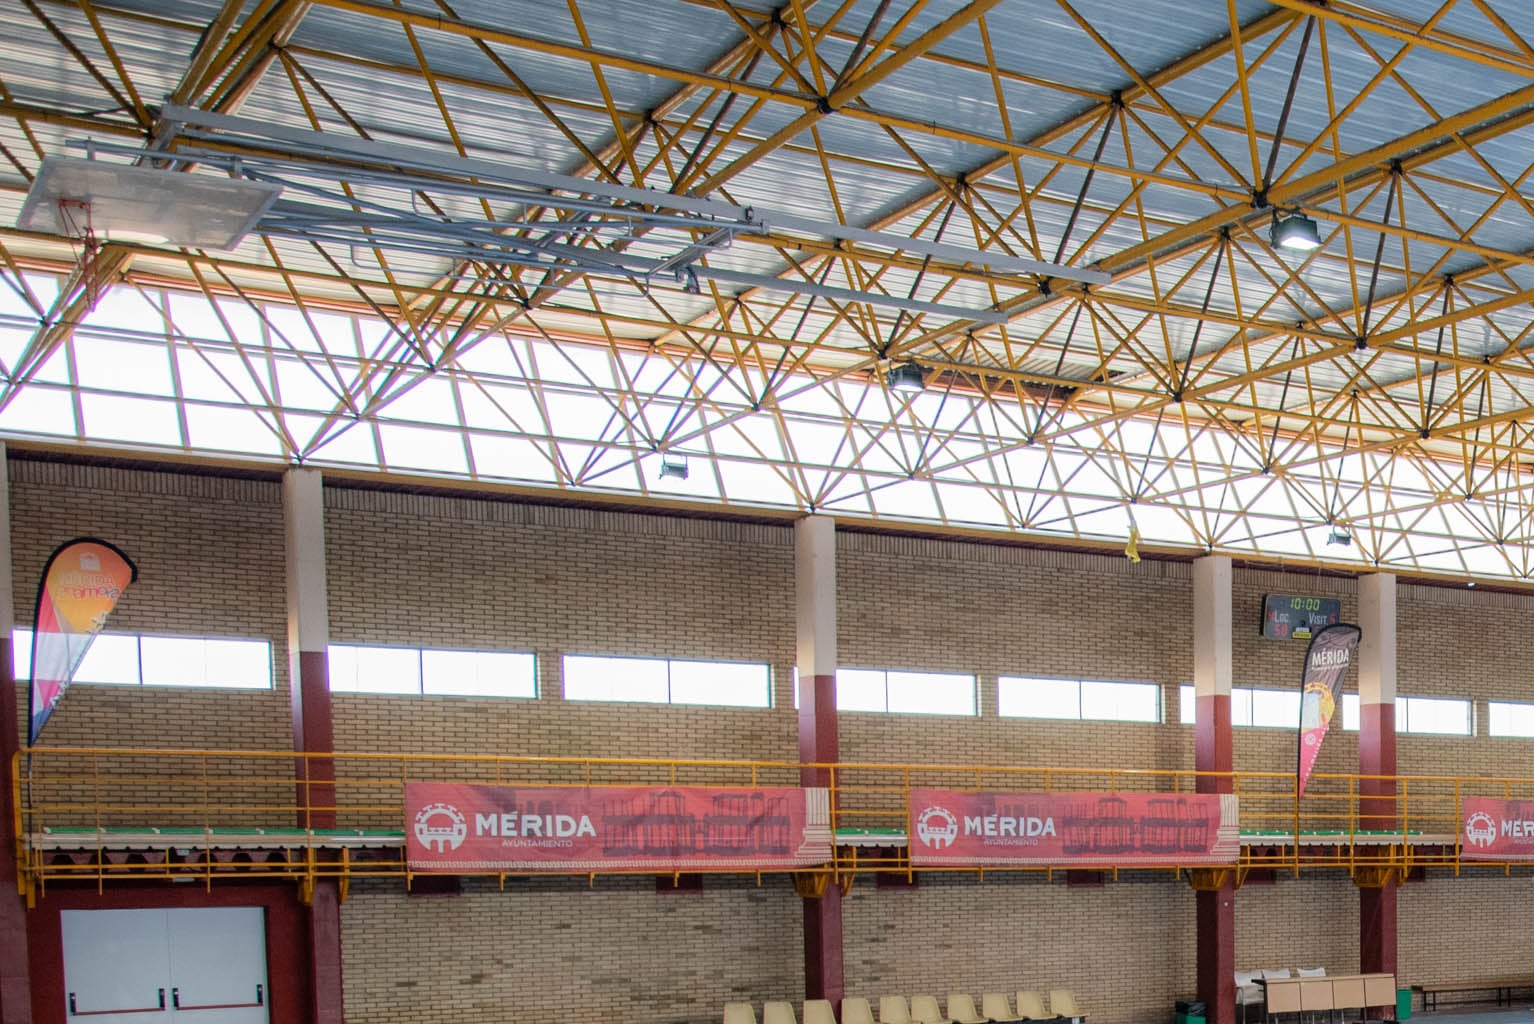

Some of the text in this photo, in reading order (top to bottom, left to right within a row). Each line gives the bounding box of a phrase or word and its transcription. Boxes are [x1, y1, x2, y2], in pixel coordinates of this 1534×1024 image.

[1290, 597, 1321, 611] 10:00
[1311, 648, 1350, 666] MÉRIDA
[475, 811, 597, 837] MÉRIDA
[963, 813, 1057, 837] MÉRIDA
[502, 839, 573, 848] AYUNTAMIENTO
